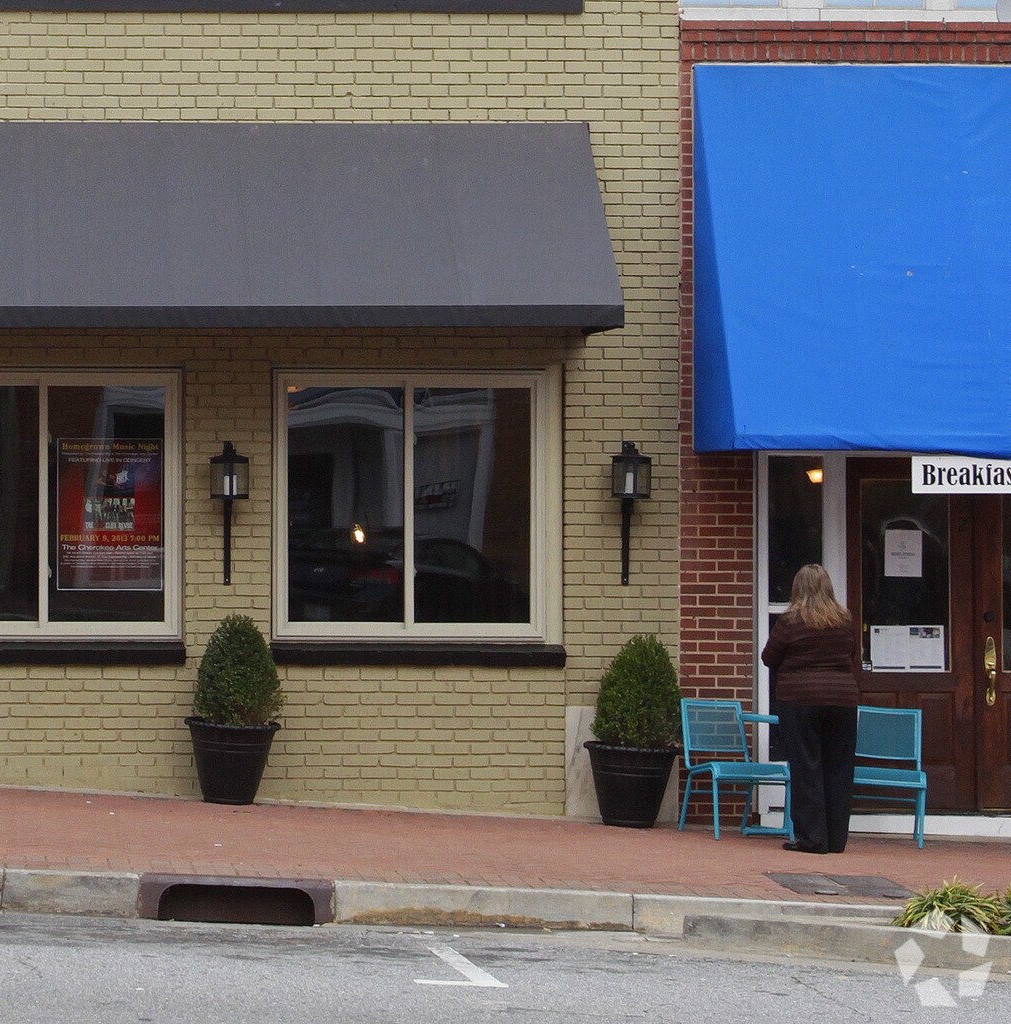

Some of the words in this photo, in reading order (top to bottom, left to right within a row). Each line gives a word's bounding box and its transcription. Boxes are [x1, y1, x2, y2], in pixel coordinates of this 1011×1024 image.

[62, 442, 109, 451] Homegrown
[112, 442, 136, 450] Music
[138, 442, 159, 452] Night
[60, 534, 100, 542] FEBRUARY
[111, 534, 128, 542] 2013
[130, 534, 146, 542] 7:00
[148, 534, 160, 542] PM
